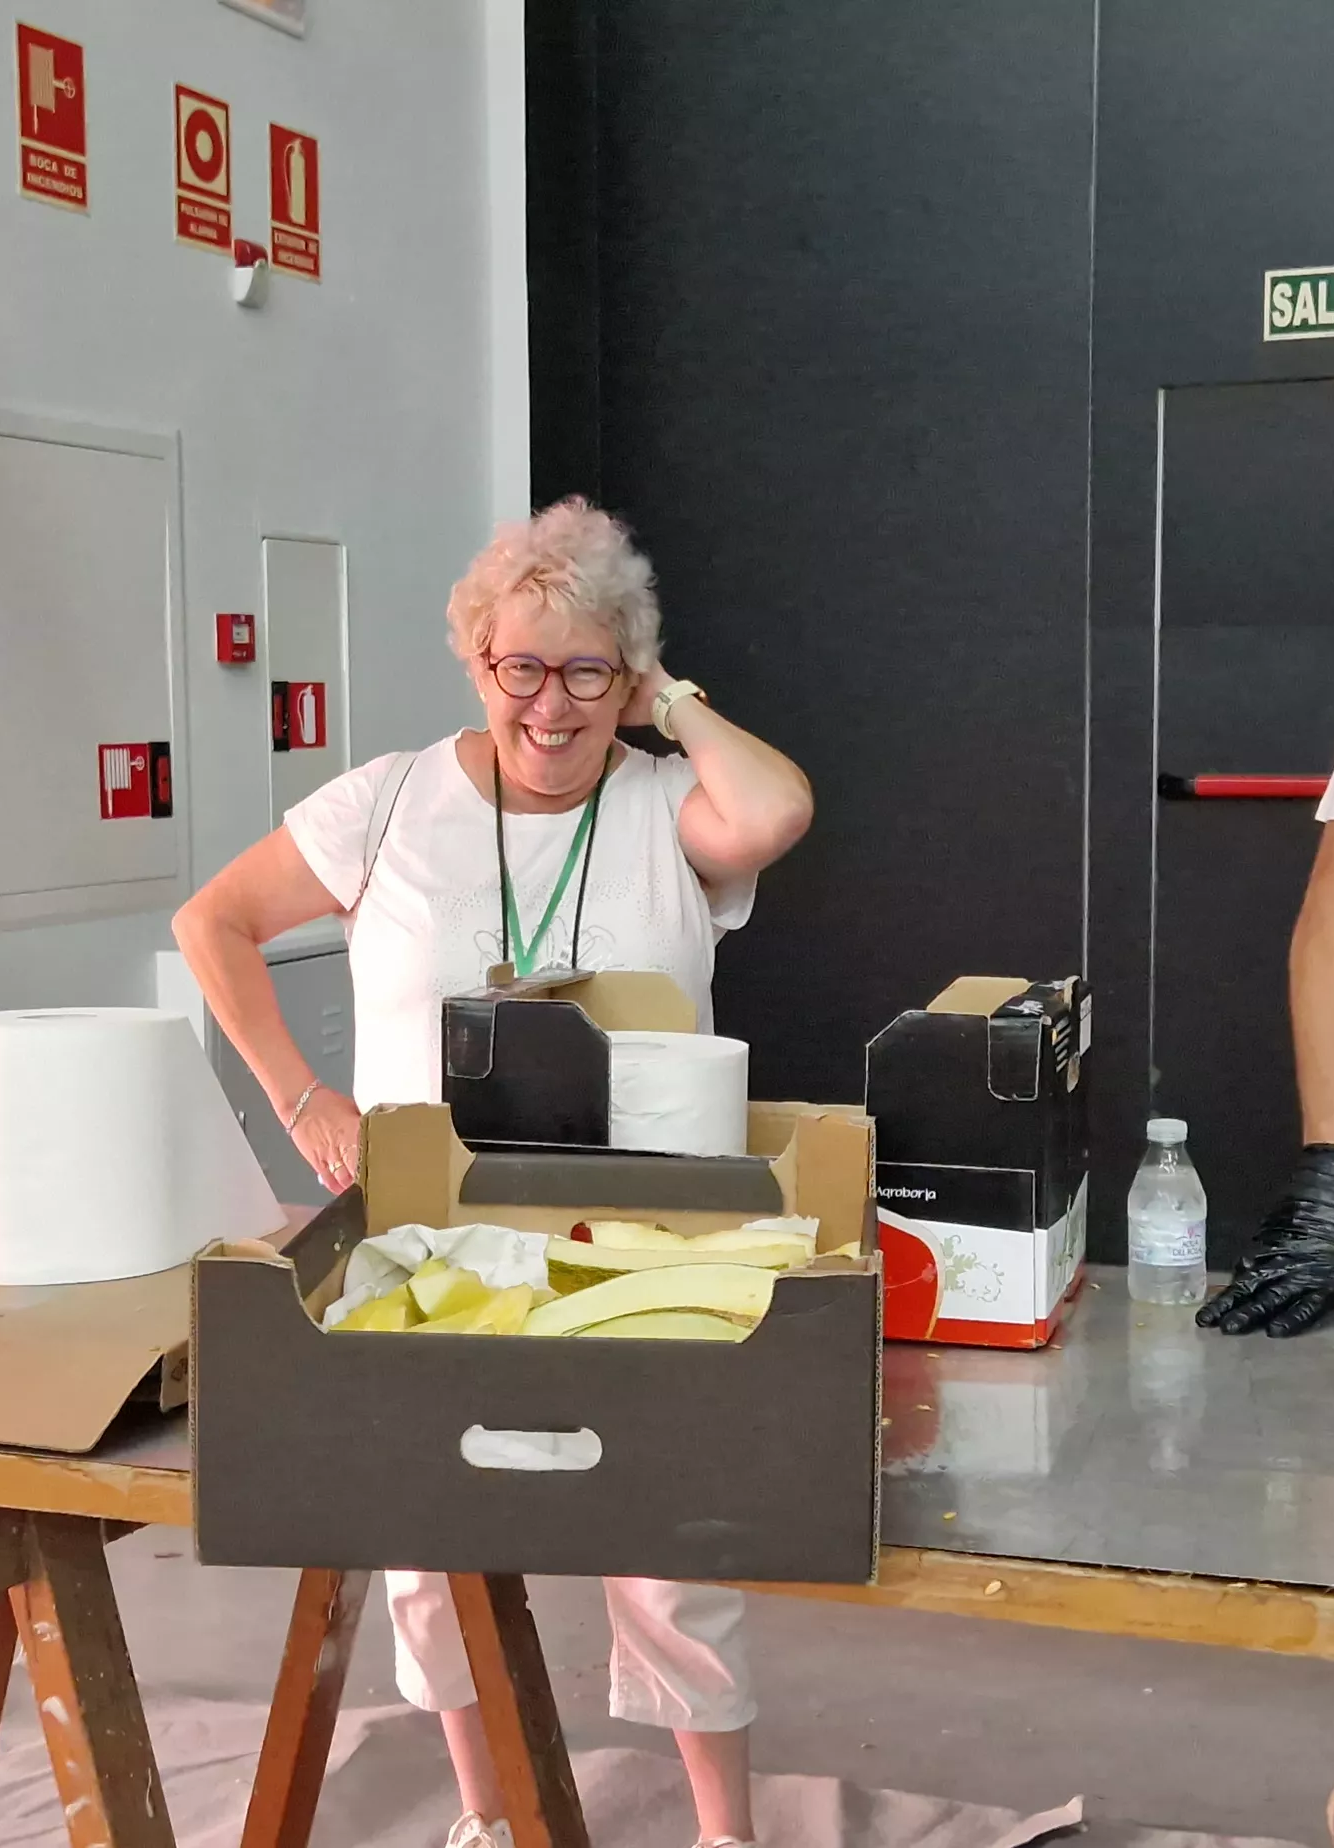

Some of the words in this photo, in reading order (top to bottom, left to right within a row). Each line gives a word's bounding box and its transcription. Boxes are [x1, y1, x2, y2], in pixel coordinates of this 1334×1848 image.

[30, 154, 58, 173] BOCA
[64, 165, 77, 179] DE
[27, 172, 83, 198] INCENDIOS
